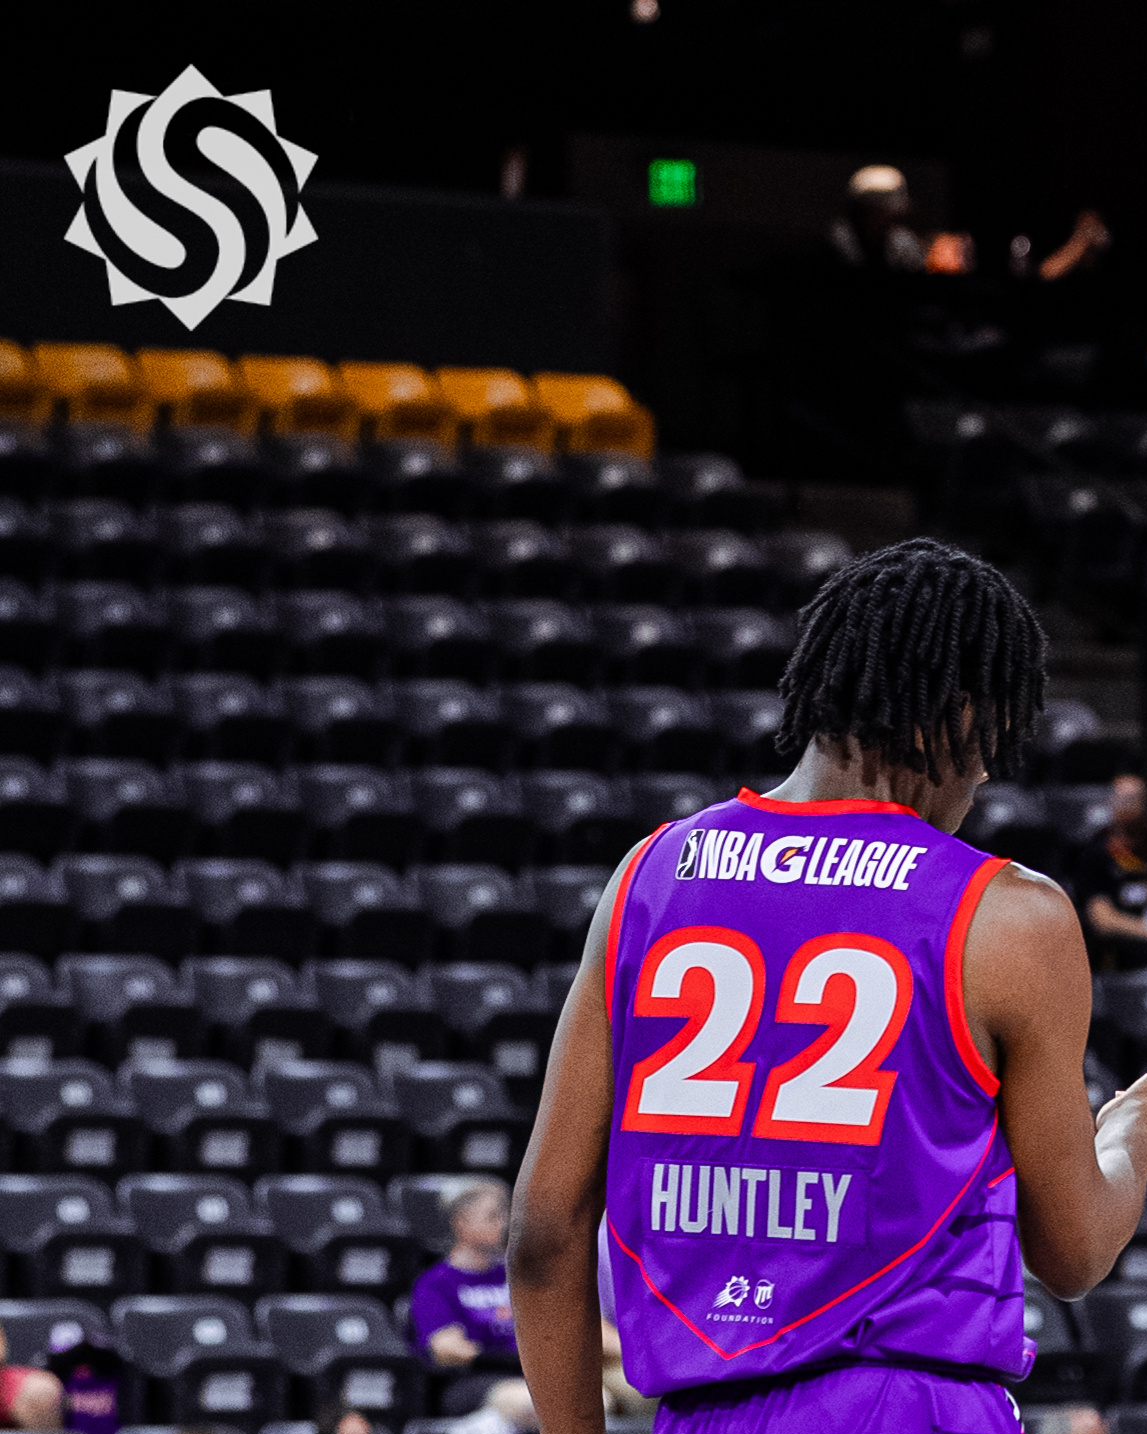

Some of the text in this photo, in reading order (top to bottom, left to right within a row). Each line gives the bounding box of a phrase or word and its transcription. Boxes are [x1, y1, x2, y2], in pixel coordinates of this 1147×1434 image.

[698, 829, 928, 891] NBA G LEAGUE
[621, 925, 914, 1147] 22
[650, 1163, 853, 1244] HUNTLEY
[705, 1313, 774, 1325] FOUNDATION
